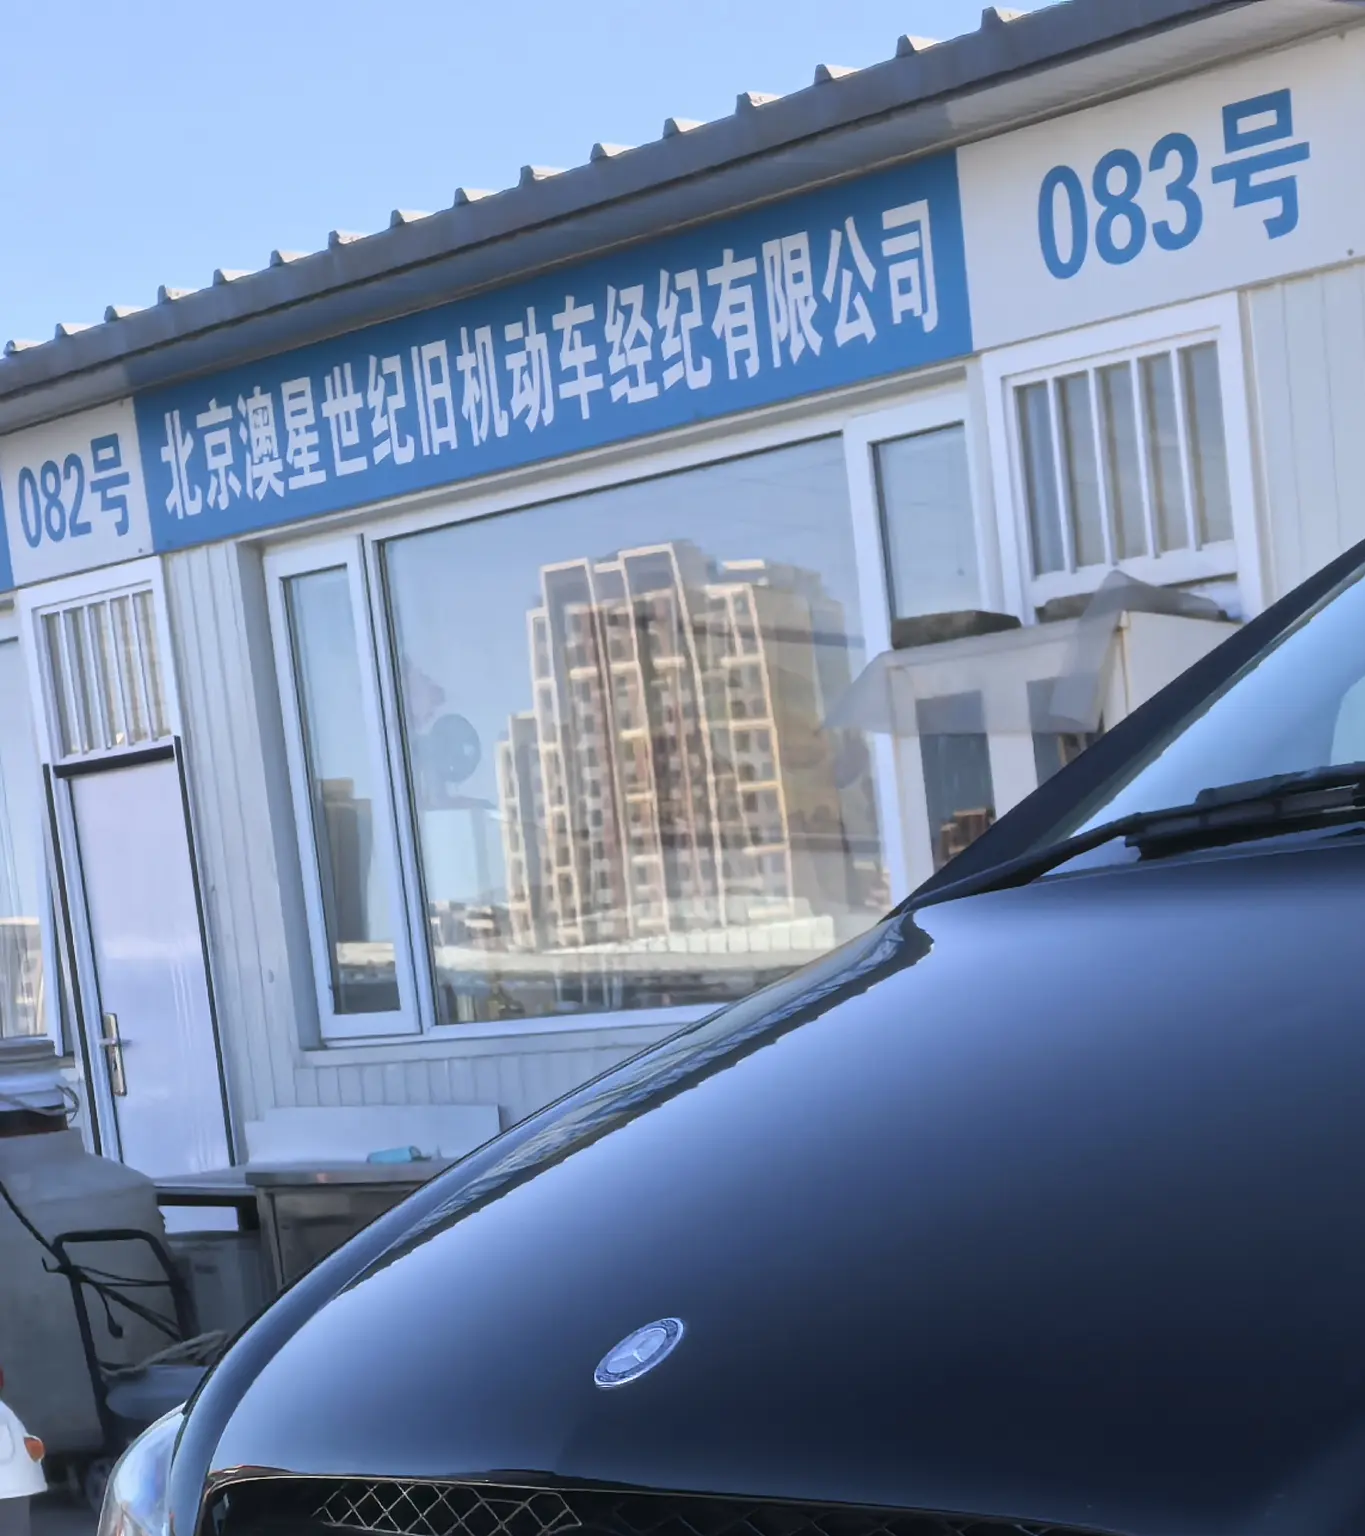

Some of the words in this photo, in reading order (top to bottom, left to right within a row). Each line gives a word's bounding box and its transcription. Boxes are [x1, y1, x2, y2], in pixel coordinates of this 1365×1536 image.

[1037, 87, 1311, 280] 083号
[159, 198, 941, 521] 北京澳星世纪旧机动车经纪有限公司
[17, 432, 130, 549] 082号
